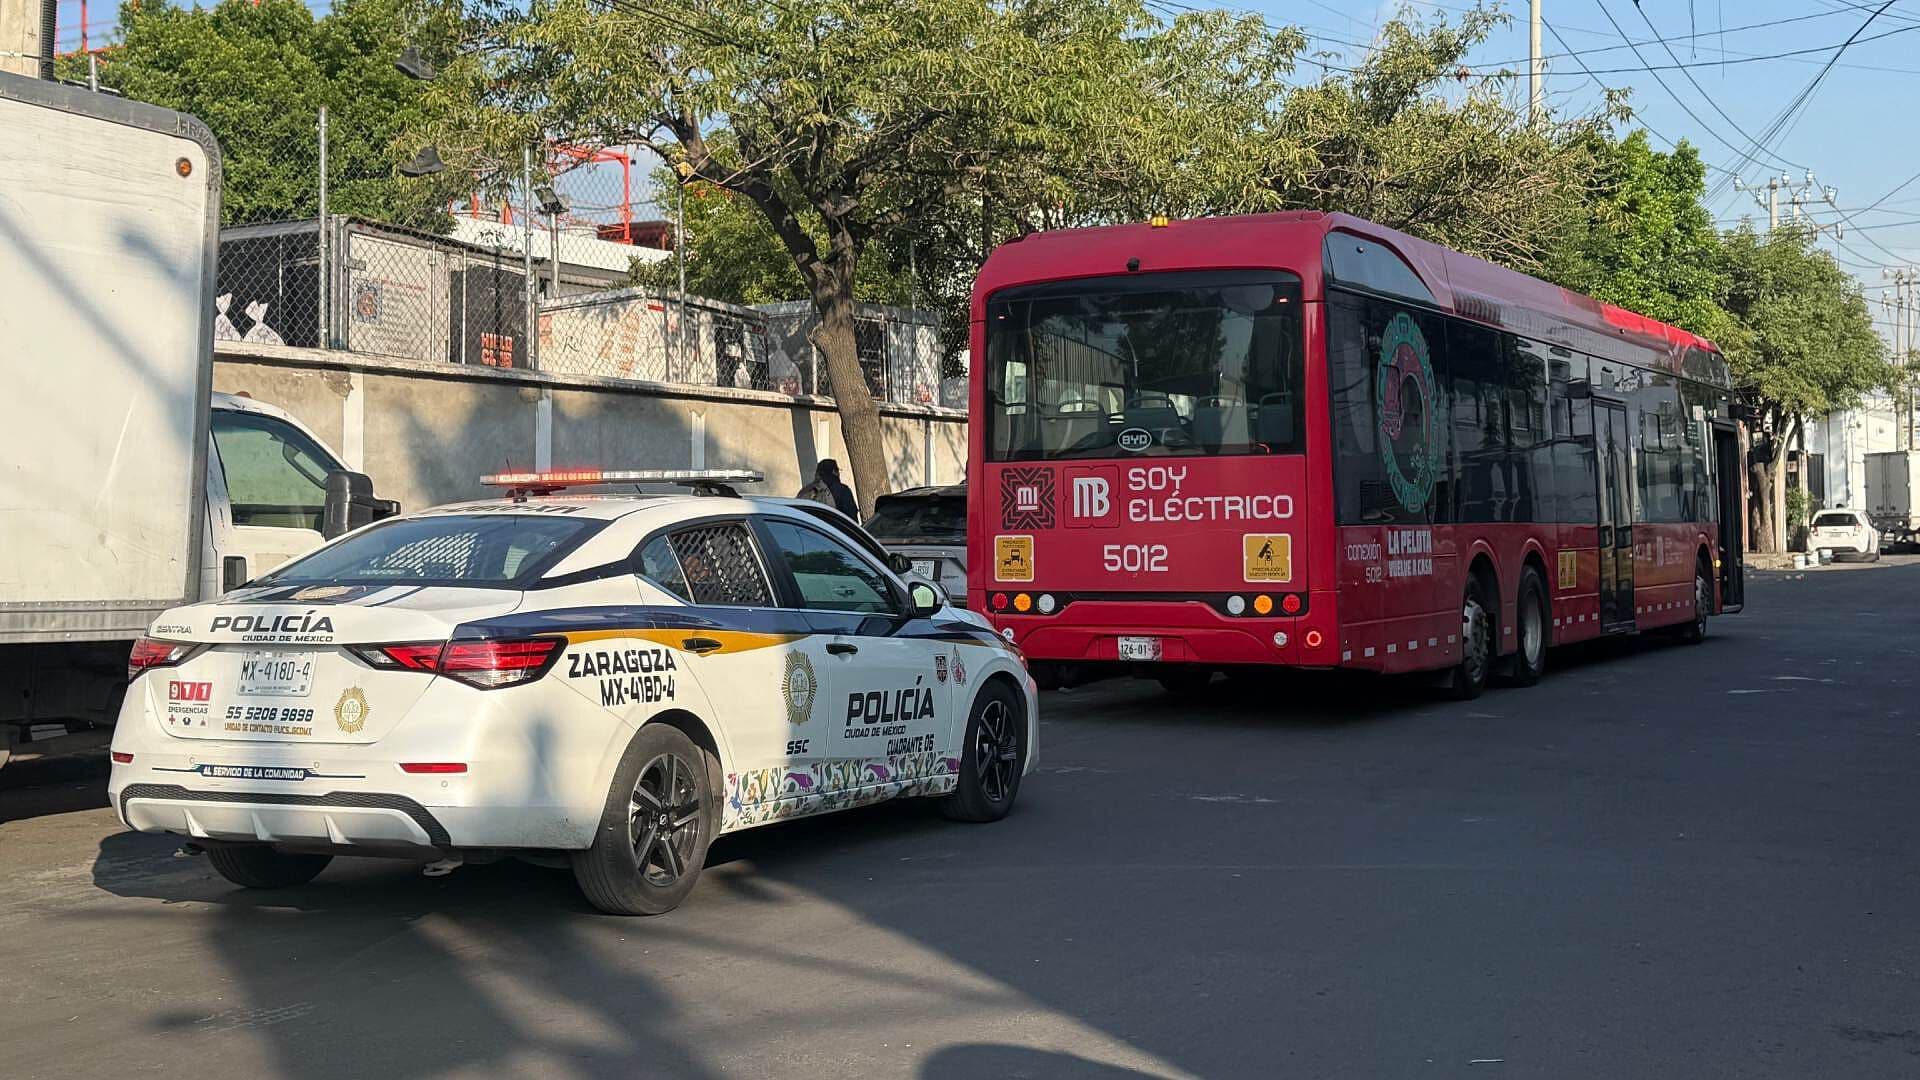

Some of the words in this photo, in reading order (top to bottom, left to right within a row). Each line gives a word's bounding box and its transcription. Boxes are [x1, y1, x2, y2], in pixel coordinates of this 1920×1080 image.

[1121, 434, 1148, 446] BYD
[1127, 465, 1188, 491] SOY
[1072, 477, 1110, 518] MB
[1127, 490, 1294, 523] ELÉCTRICO
[1388, 530, 1399, 555] LA
[1401, 530, 1432, 554] PELOTA
[1103, 544, 1169, 572] 5012
[1412, 559, 1417, 576] A
[1418, 559, 1433, 576] CASA
[209, 609, 334, 633] POLICÍA
[294, 634, 333, 642] MÉXICO
[241, 660, 311, 680] MX-418D-4
[567, 649, 677, 678] ZARAGOZA
[170, 682, 210, 699] 911
[600, 675, 675, 706] MX-418D-4
[845, 675, 935, 726] POLICÍA
[168, 706, 208, 714] EMERGENCIAS
[226, 706, 243, 719] 55
[245, 707, 278, 720] 5208
[280, 708, 314, 721] 9898
[224, 722, 240, 731] UNIDAD
[242, 723, 249, 731] DE
[249, 723, 272, 733] CONTACTO
[844, 728, 870, 738] CIUDAD
[871, 728, 880, 737] DE
[882, 724, 907, 736] MÉXICO
[786, 739, 810, 755] SSC
[886, 736, 923, 756] CUADRANTE
[203, 766, 212, 775] AL
[213, 766, 242, 777] SERVICIO
[243, 768, 253, 777] DE
[253, 768, 263, 778] LA
[264, 769, 304, 779] COMUNIDAD
